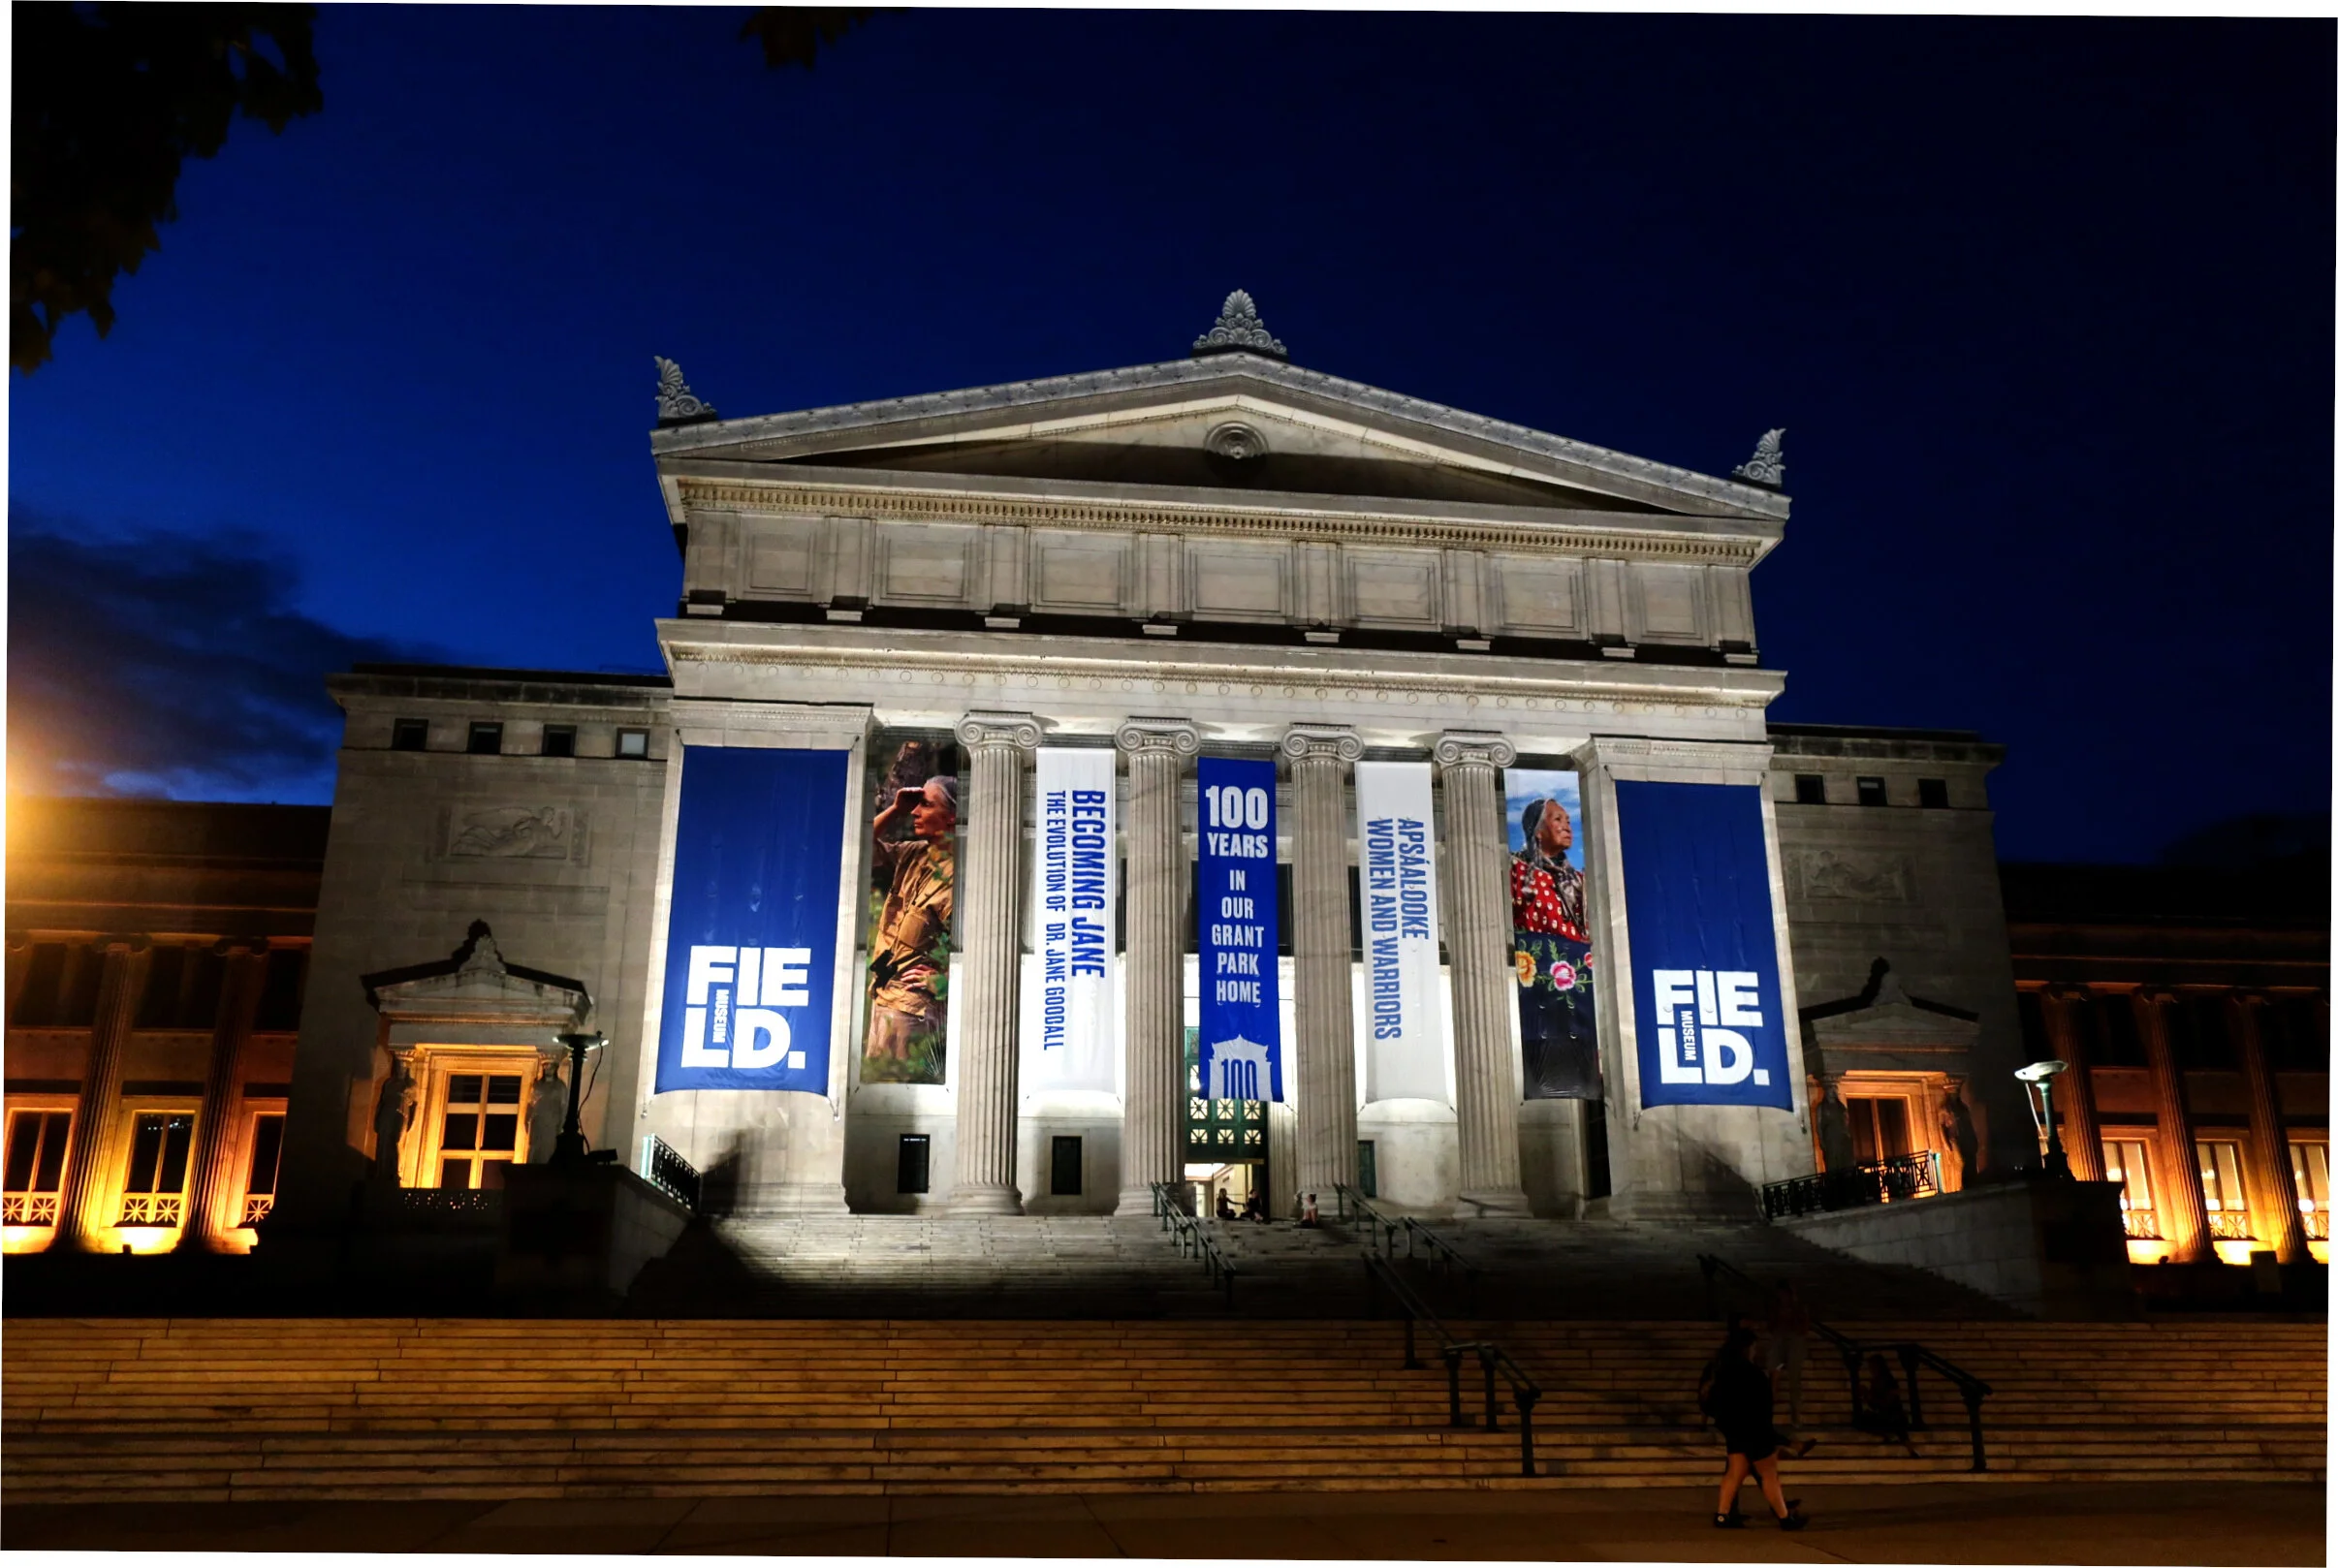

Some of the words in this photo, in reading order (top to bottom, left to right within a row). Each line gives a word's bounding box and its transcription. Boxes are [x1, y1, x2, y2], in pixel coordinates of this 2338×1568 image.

[1046, 790, 1066, 815] THE
[1205, 785, 1268, 830] 100
[1046, 819, 1066, 892] EVOLUTION
[1072, 790, 1106, 910] BECOMING
[1207, 831, 1268, 859] YEARS
[1367, 818, 1396, 889] WOMEN
[1229, 869, 1246, 891] IN
[1398, 818, 1430, 940] APSÁALOOKE
[1046, 895, 1066, 912] OF
[1221, 896, 1254, 920] OUR
[1371, 894, 1398, 931] AND
[1045, 923, 1065, 946] DR.
[1071, 917, 1105, 978] JANE
[1212, 924, 1265, 948] GRANT
[1045, 949, 1065, 984] JANE
[1216, 952, 1260, 976] PARK
[1216, 980, 1261, 1004] HOME
[1373, 936, 1402, 1040] WARRIORS
[712, 988, 729, 1043] MUSEUM
[1043, 987, 1065, 1051] GOODALL
[1680, 1010, 1697, 1061] MUSEUM
[1221, 1058, 1259, 1100] 100
